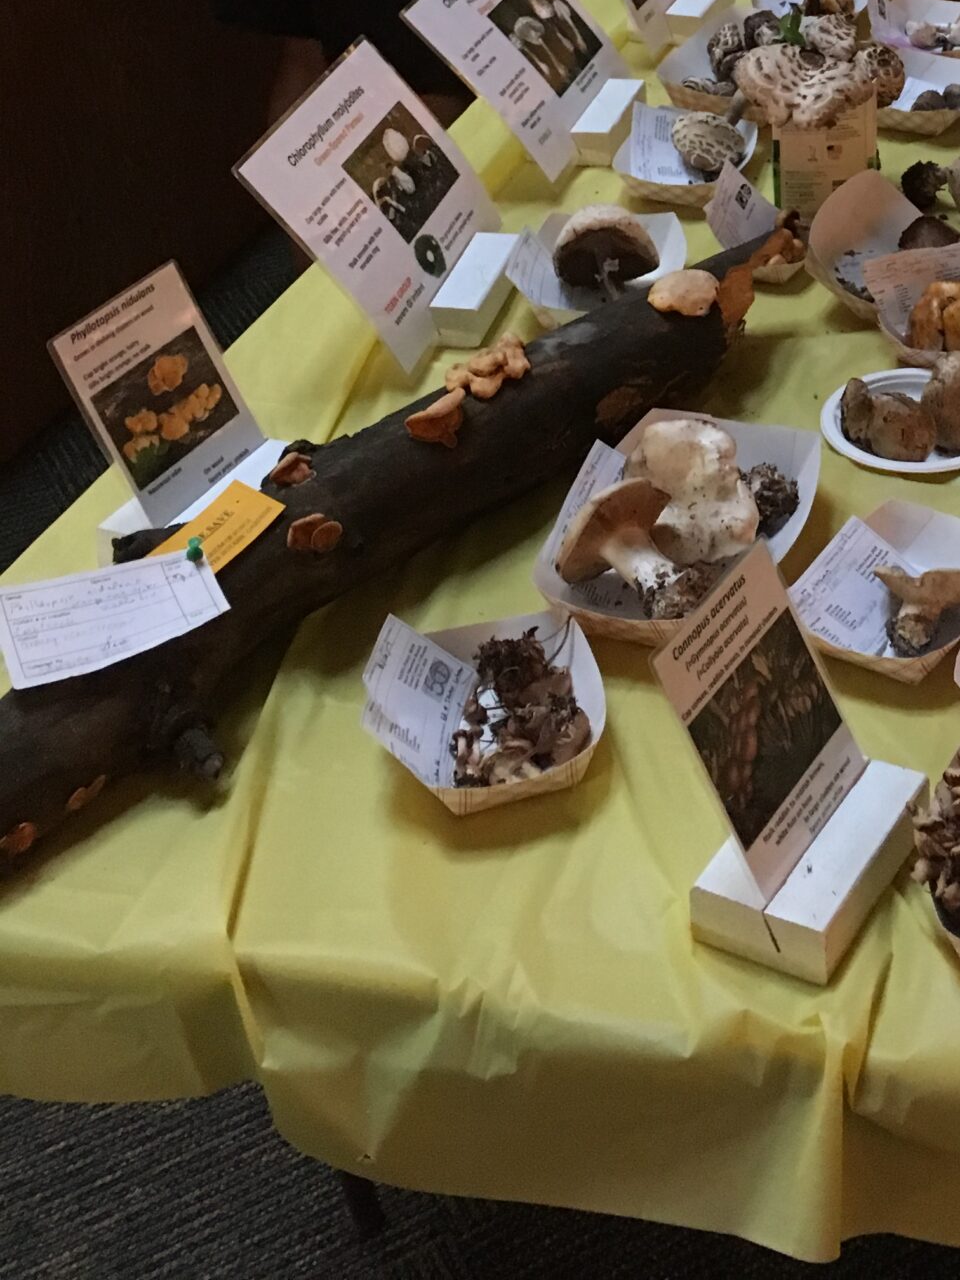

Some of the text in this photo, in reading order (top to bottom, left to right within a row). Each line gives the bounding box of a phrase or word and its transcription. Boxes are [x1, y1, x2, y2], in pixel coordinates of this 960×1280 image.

[287, 86, 365, 167] Chlorophyllum molybdites
[70, 284, 155, 344] Phyllotopsis nidulans
[672, 575, 746, 661] Connopus acervatus
